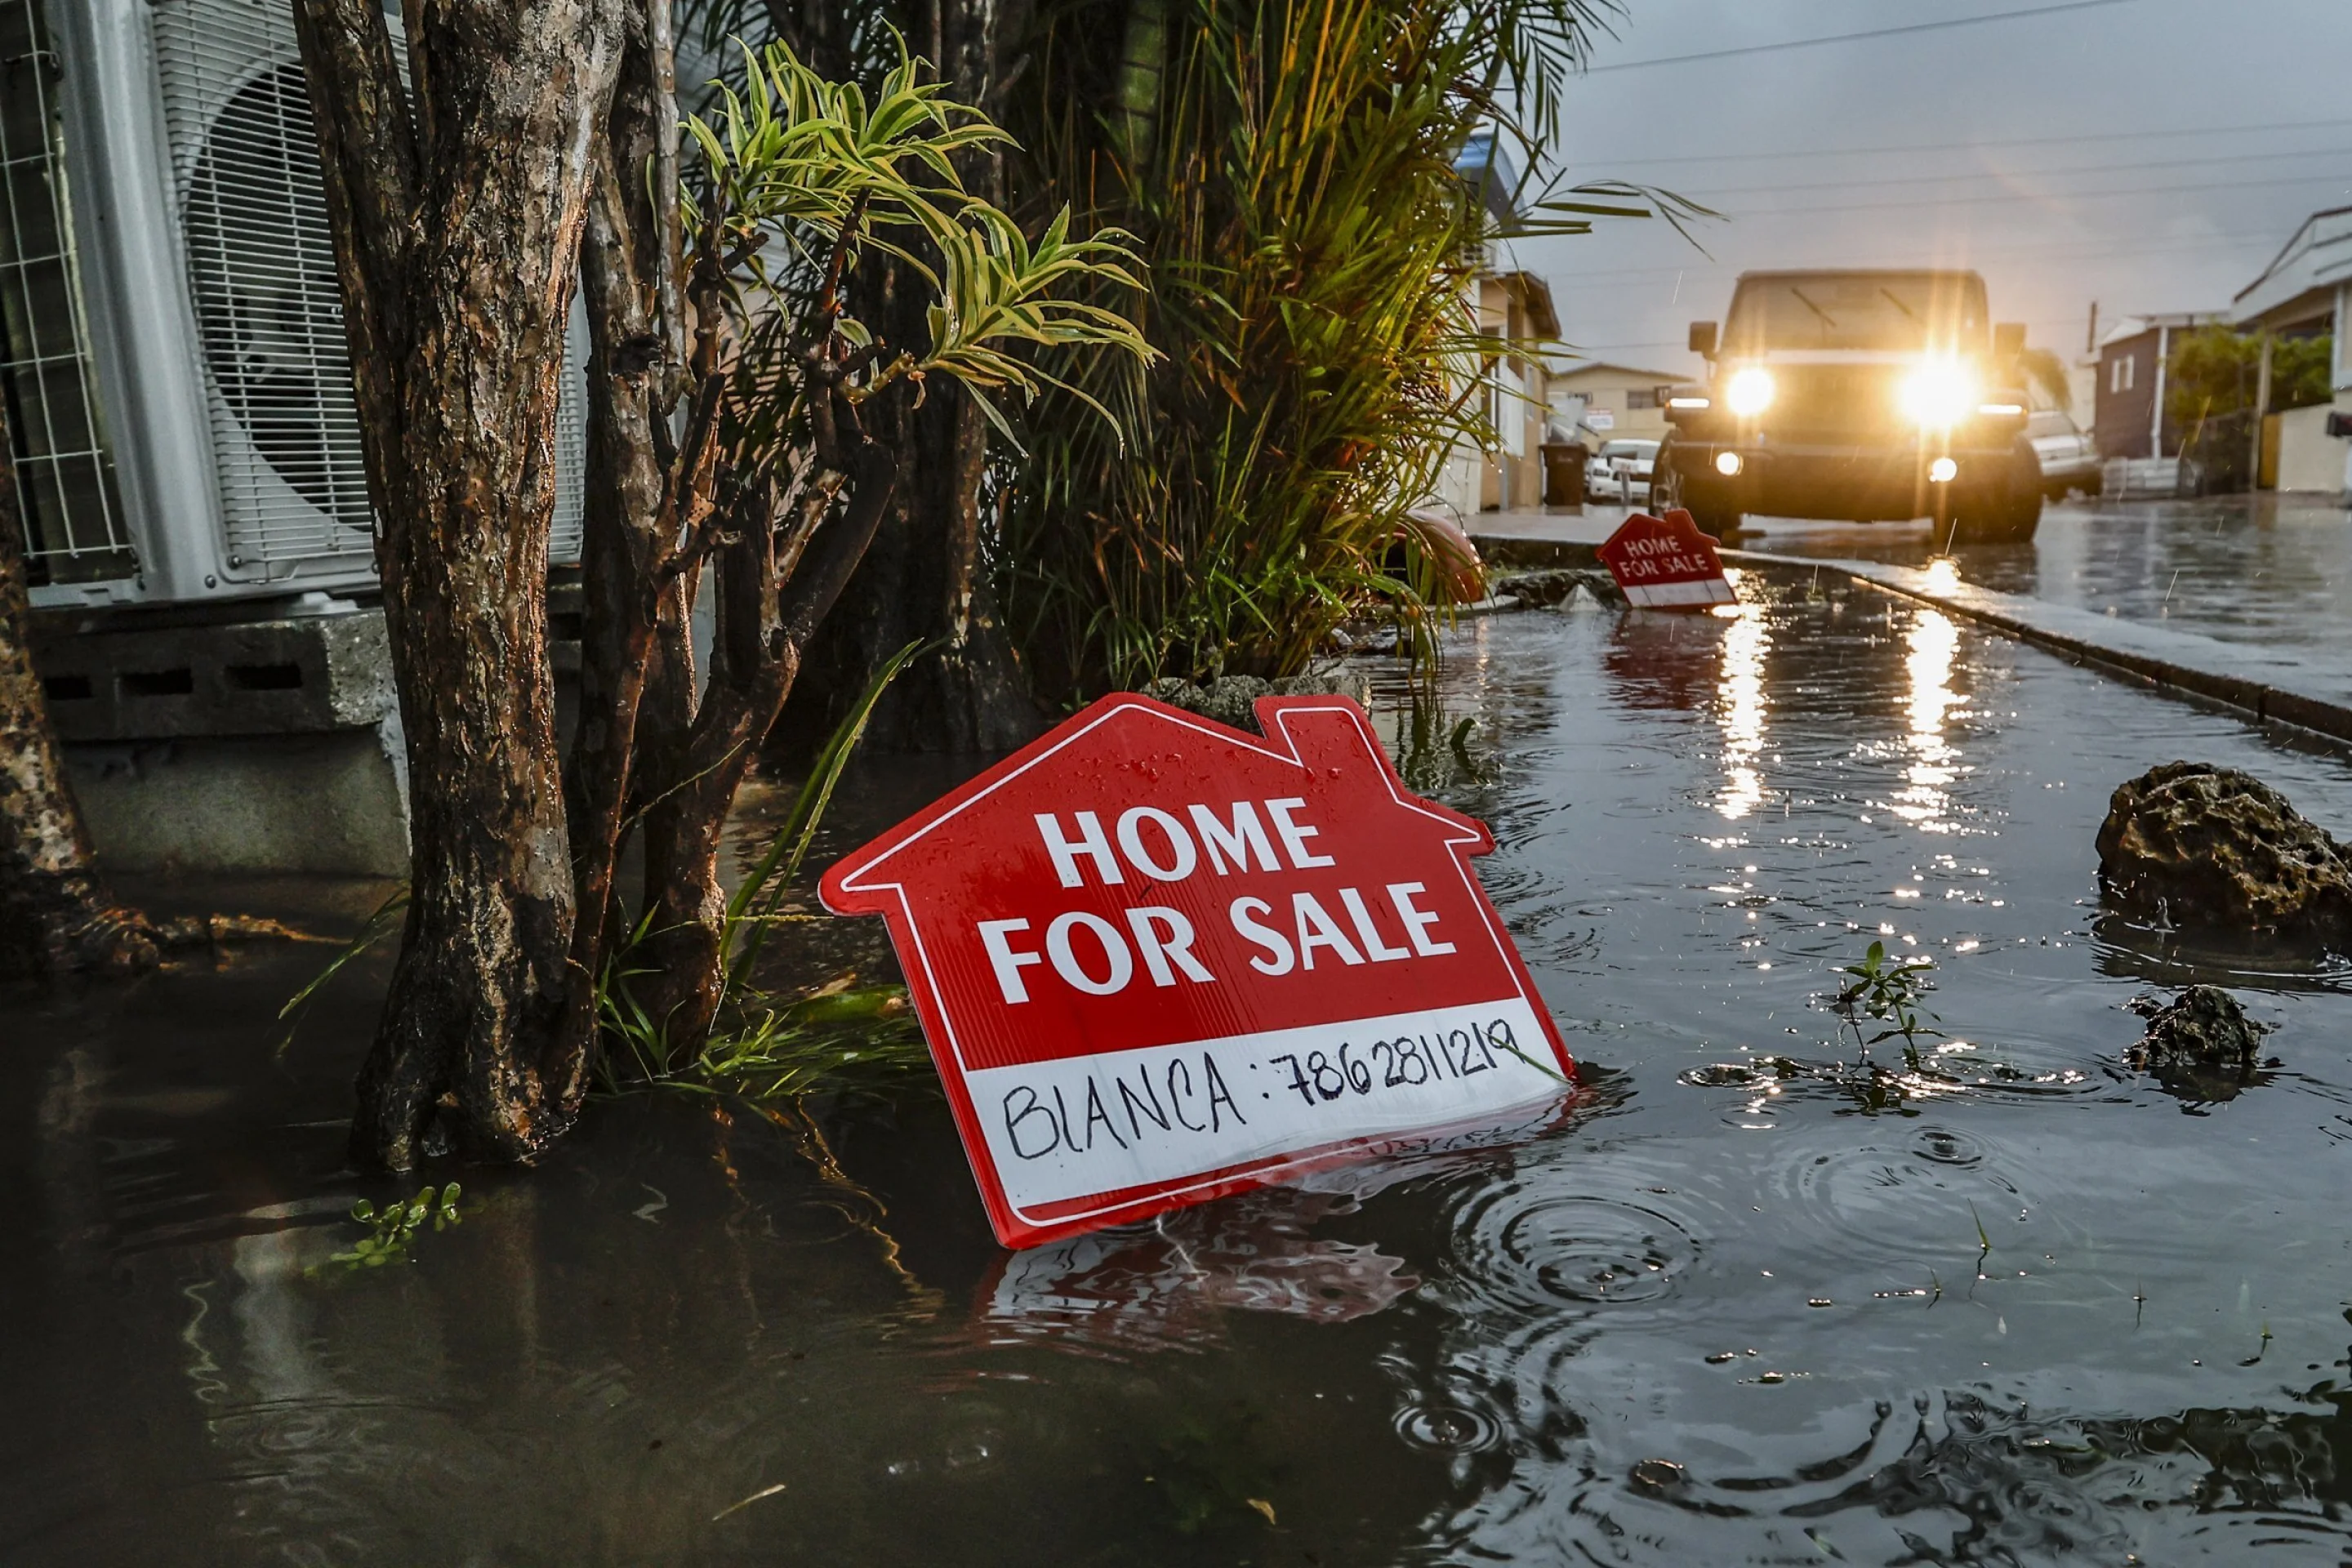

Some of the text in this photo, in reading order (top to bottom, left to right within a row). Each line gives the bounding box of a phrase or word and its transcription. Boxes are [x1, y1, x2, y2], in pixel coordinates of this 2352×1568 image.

[1619, 554, 1708, 578] FOR SALE
[1624, 536, 1682, 558] HOME
[1034, 797, 1335, 888] HOME
[978, 881, 1456, 1004] FOR SALE
